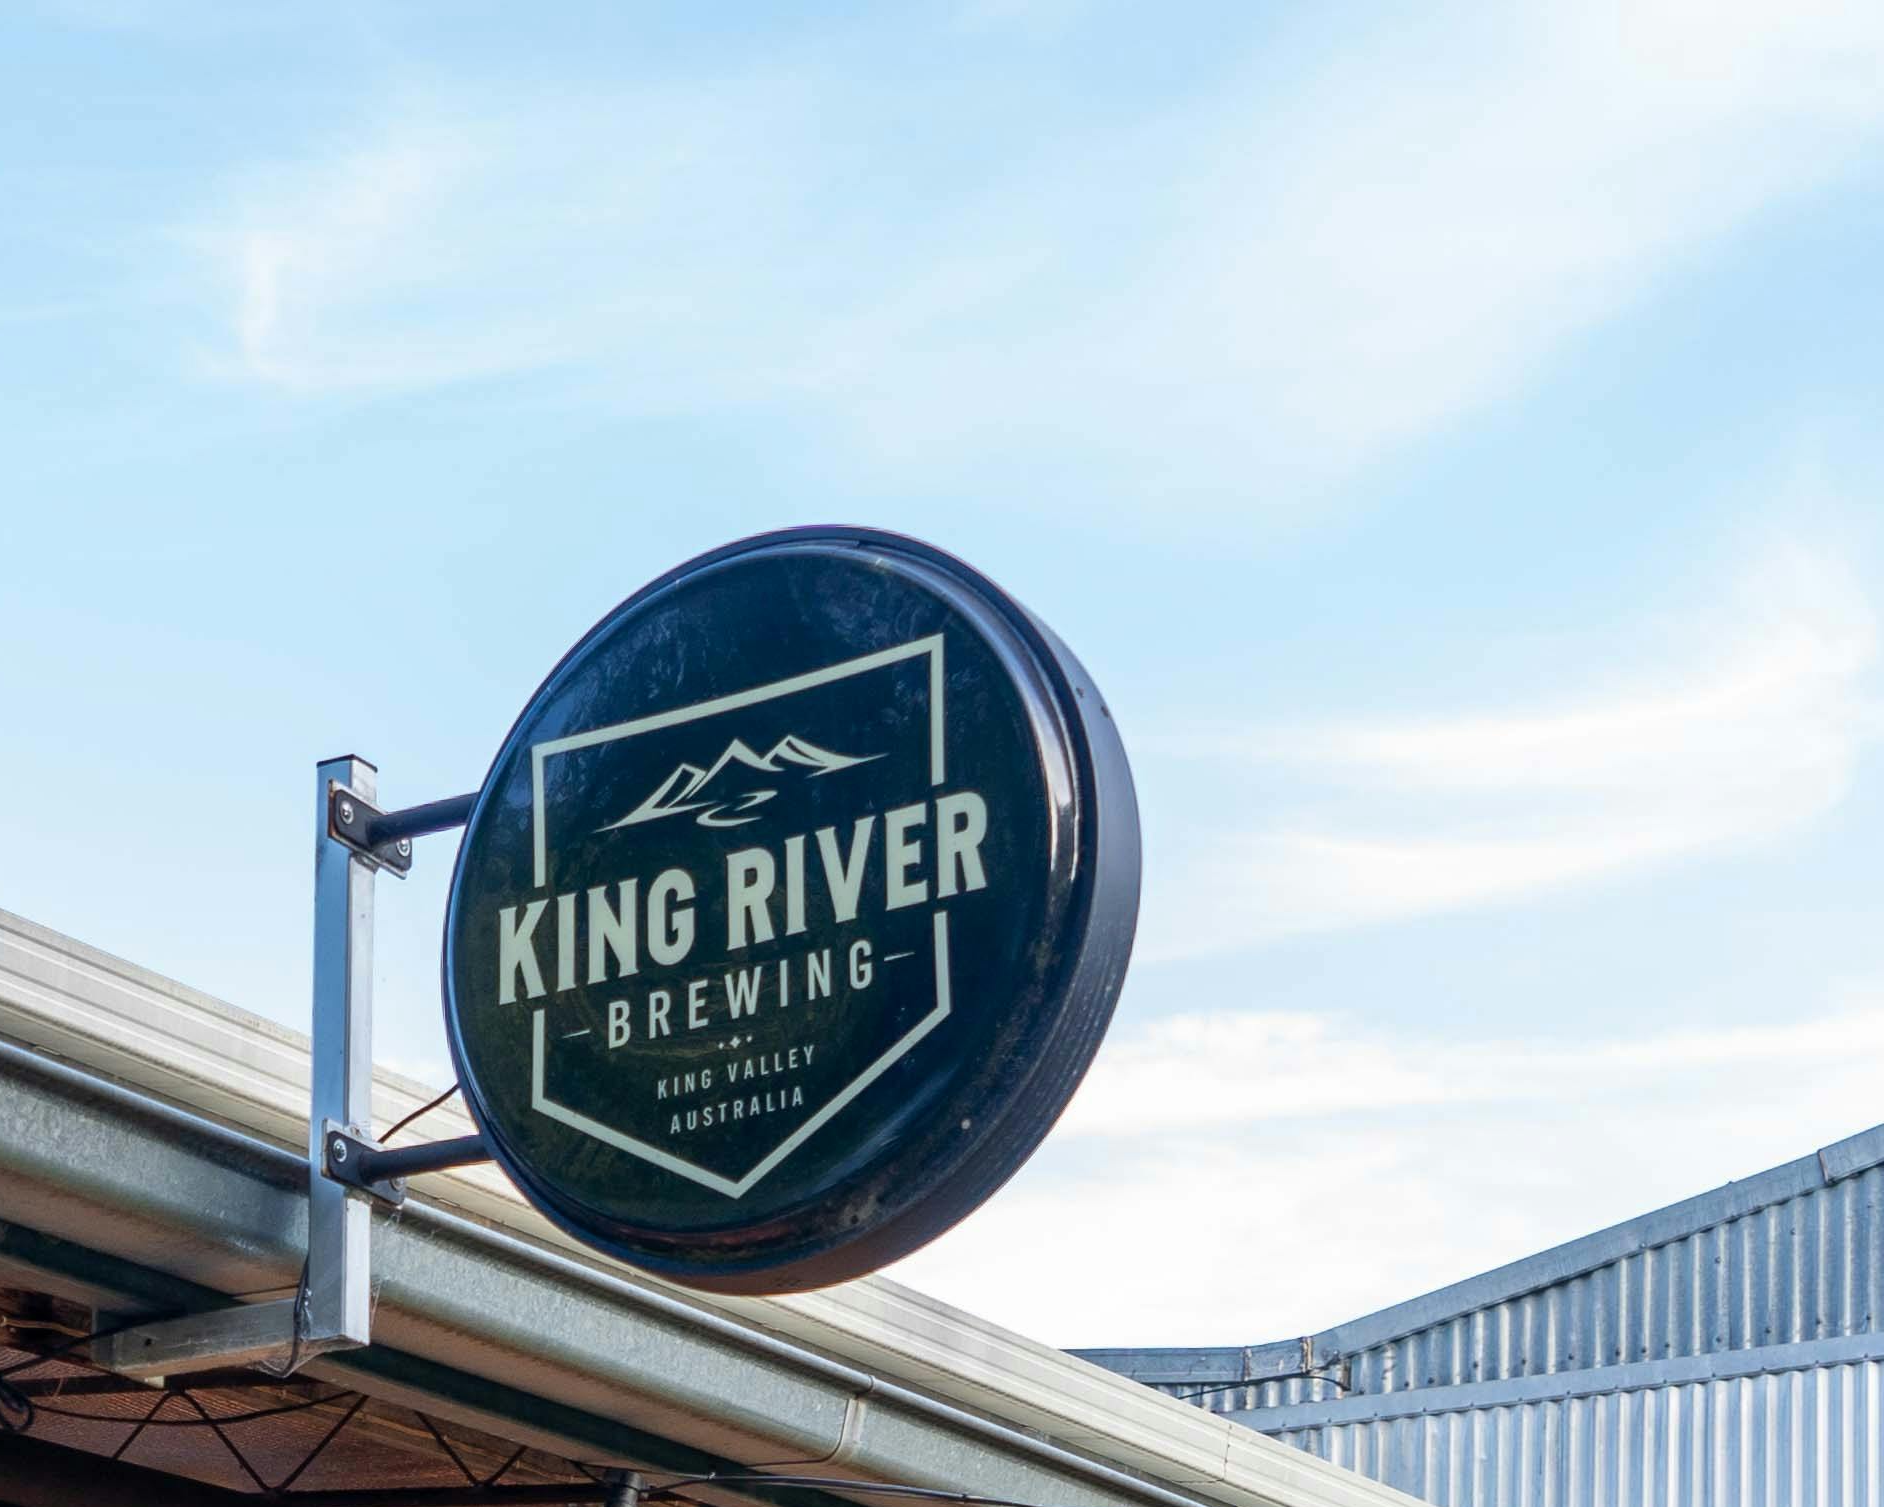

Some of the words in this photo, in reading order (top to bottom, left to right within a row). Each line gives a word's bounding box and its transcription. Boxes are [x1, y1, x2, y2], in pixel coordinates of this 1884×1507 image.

[497, 868, 698, 1006] KING
[725, 790, 988, 952] RIVER
[608, 939, 874, 1051] BREWING
[656, 1070, 712, 1101] KING
[726, 1044, 817, 1083] VALLEY
[669, 1086, 805, 1135] AUSTRALIA
